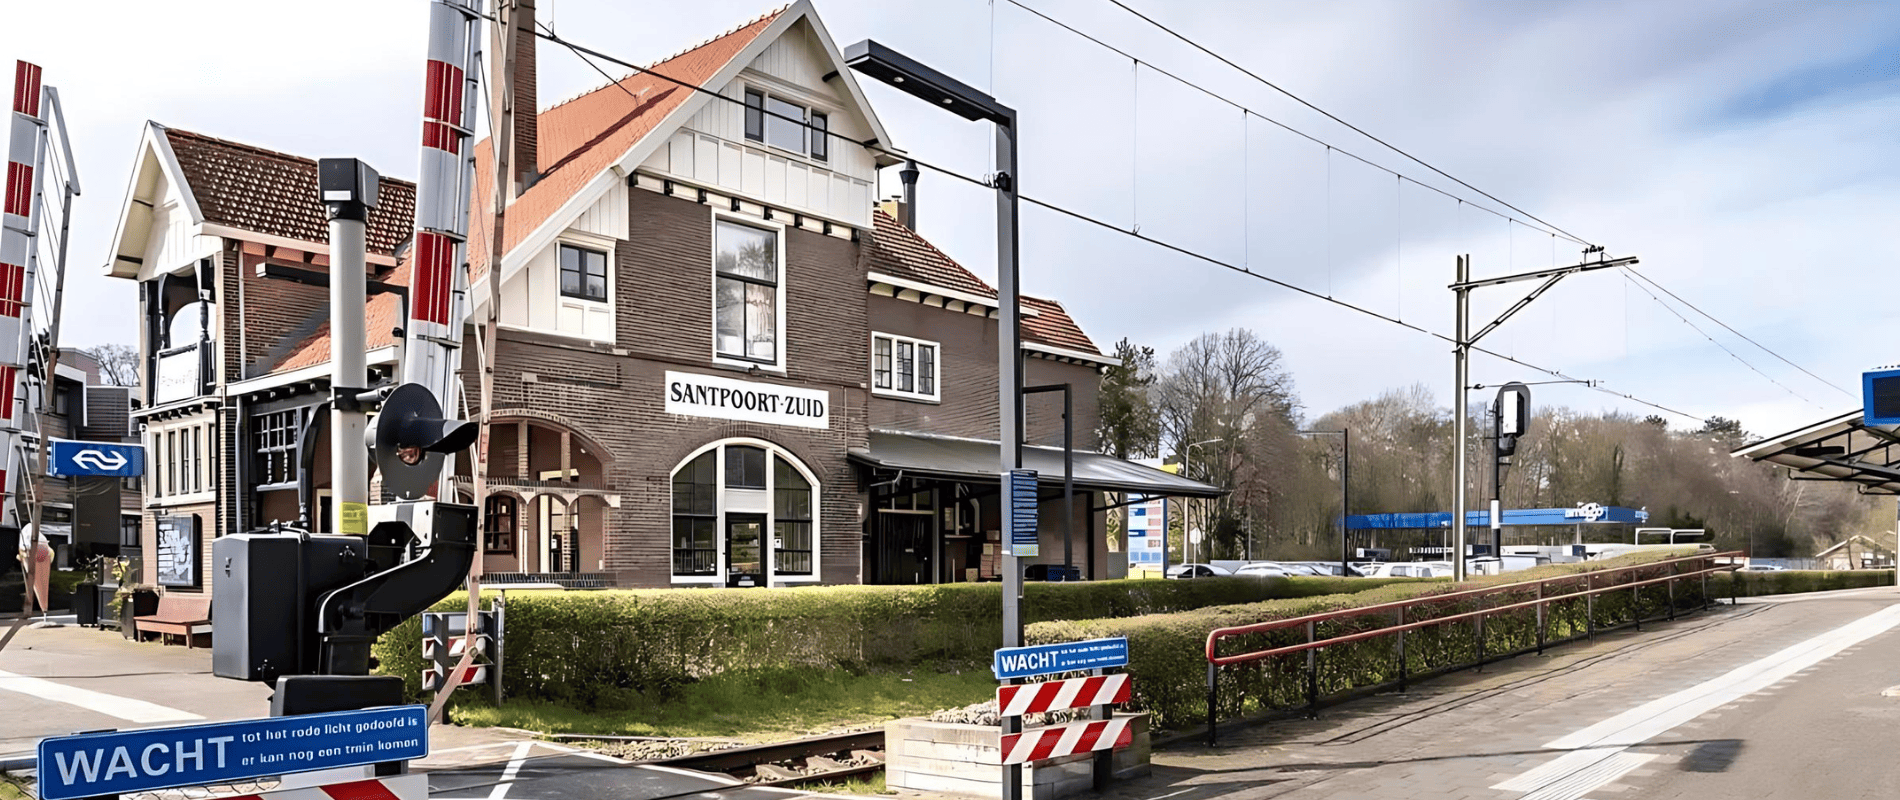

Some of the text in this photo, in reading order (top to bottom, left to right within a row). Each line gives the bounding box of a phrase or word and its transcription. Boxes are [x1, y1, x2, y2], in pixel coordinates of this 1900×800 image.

[1001, 650, 1059, 673] WACHT
[242, 732, 261, 743] tot
[325, 722, 351, 735] licht
[54, 735, 235, 786] WACHT
[289, 750, 314, 761] nog
